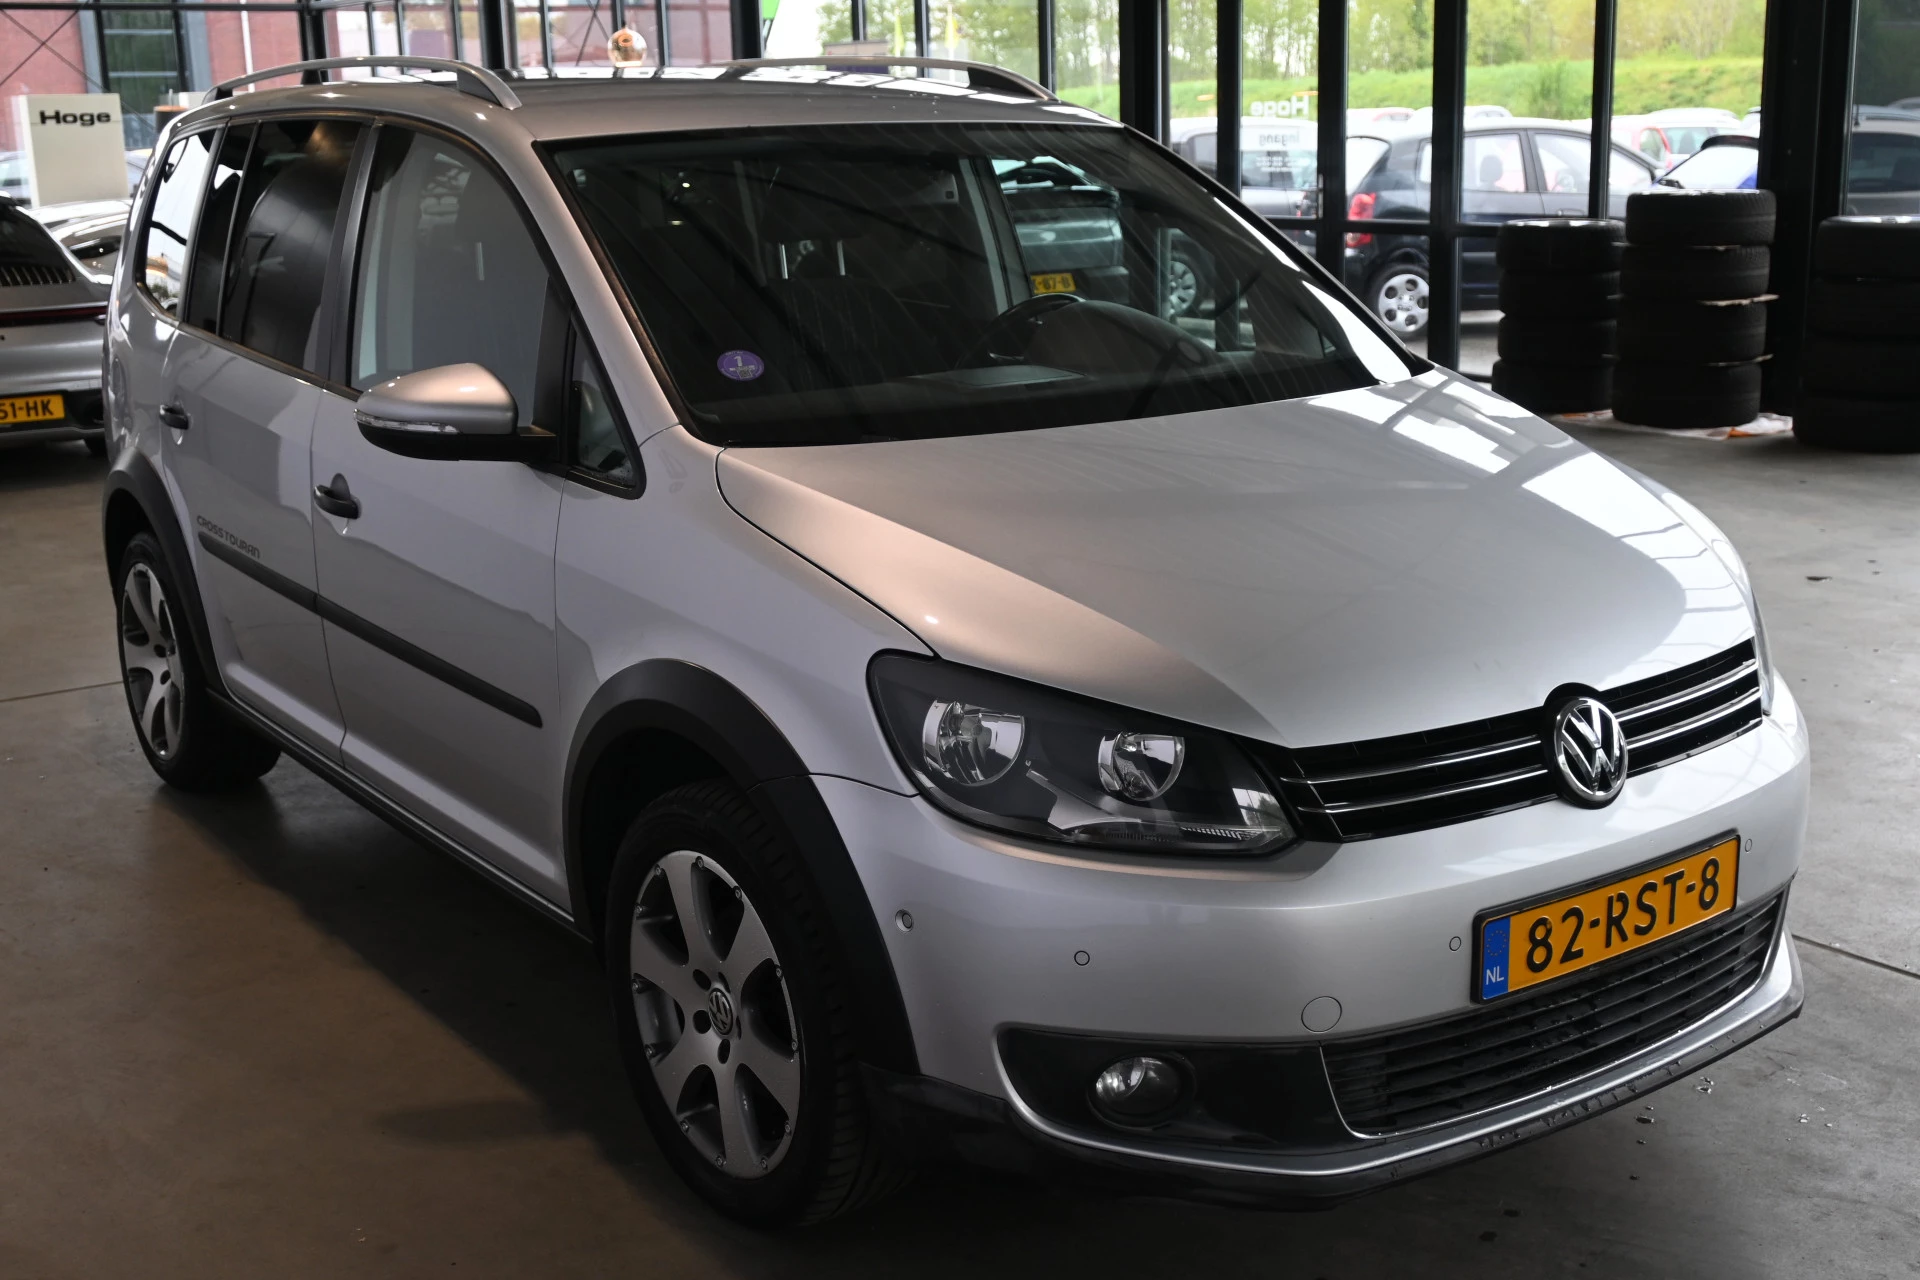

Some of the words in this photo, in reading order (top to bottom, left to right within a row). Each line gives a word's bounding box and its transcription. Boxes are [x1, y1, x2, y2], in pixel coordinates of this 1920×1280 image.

[39, 110, 111, 126] Hoge
[734, 356, 743, 367] 1
[0, 400, 54, 419] 51-HK
[1526, 857, 1719, 973] 82-RST-8
[1486, 967, 1505, 985] NL
